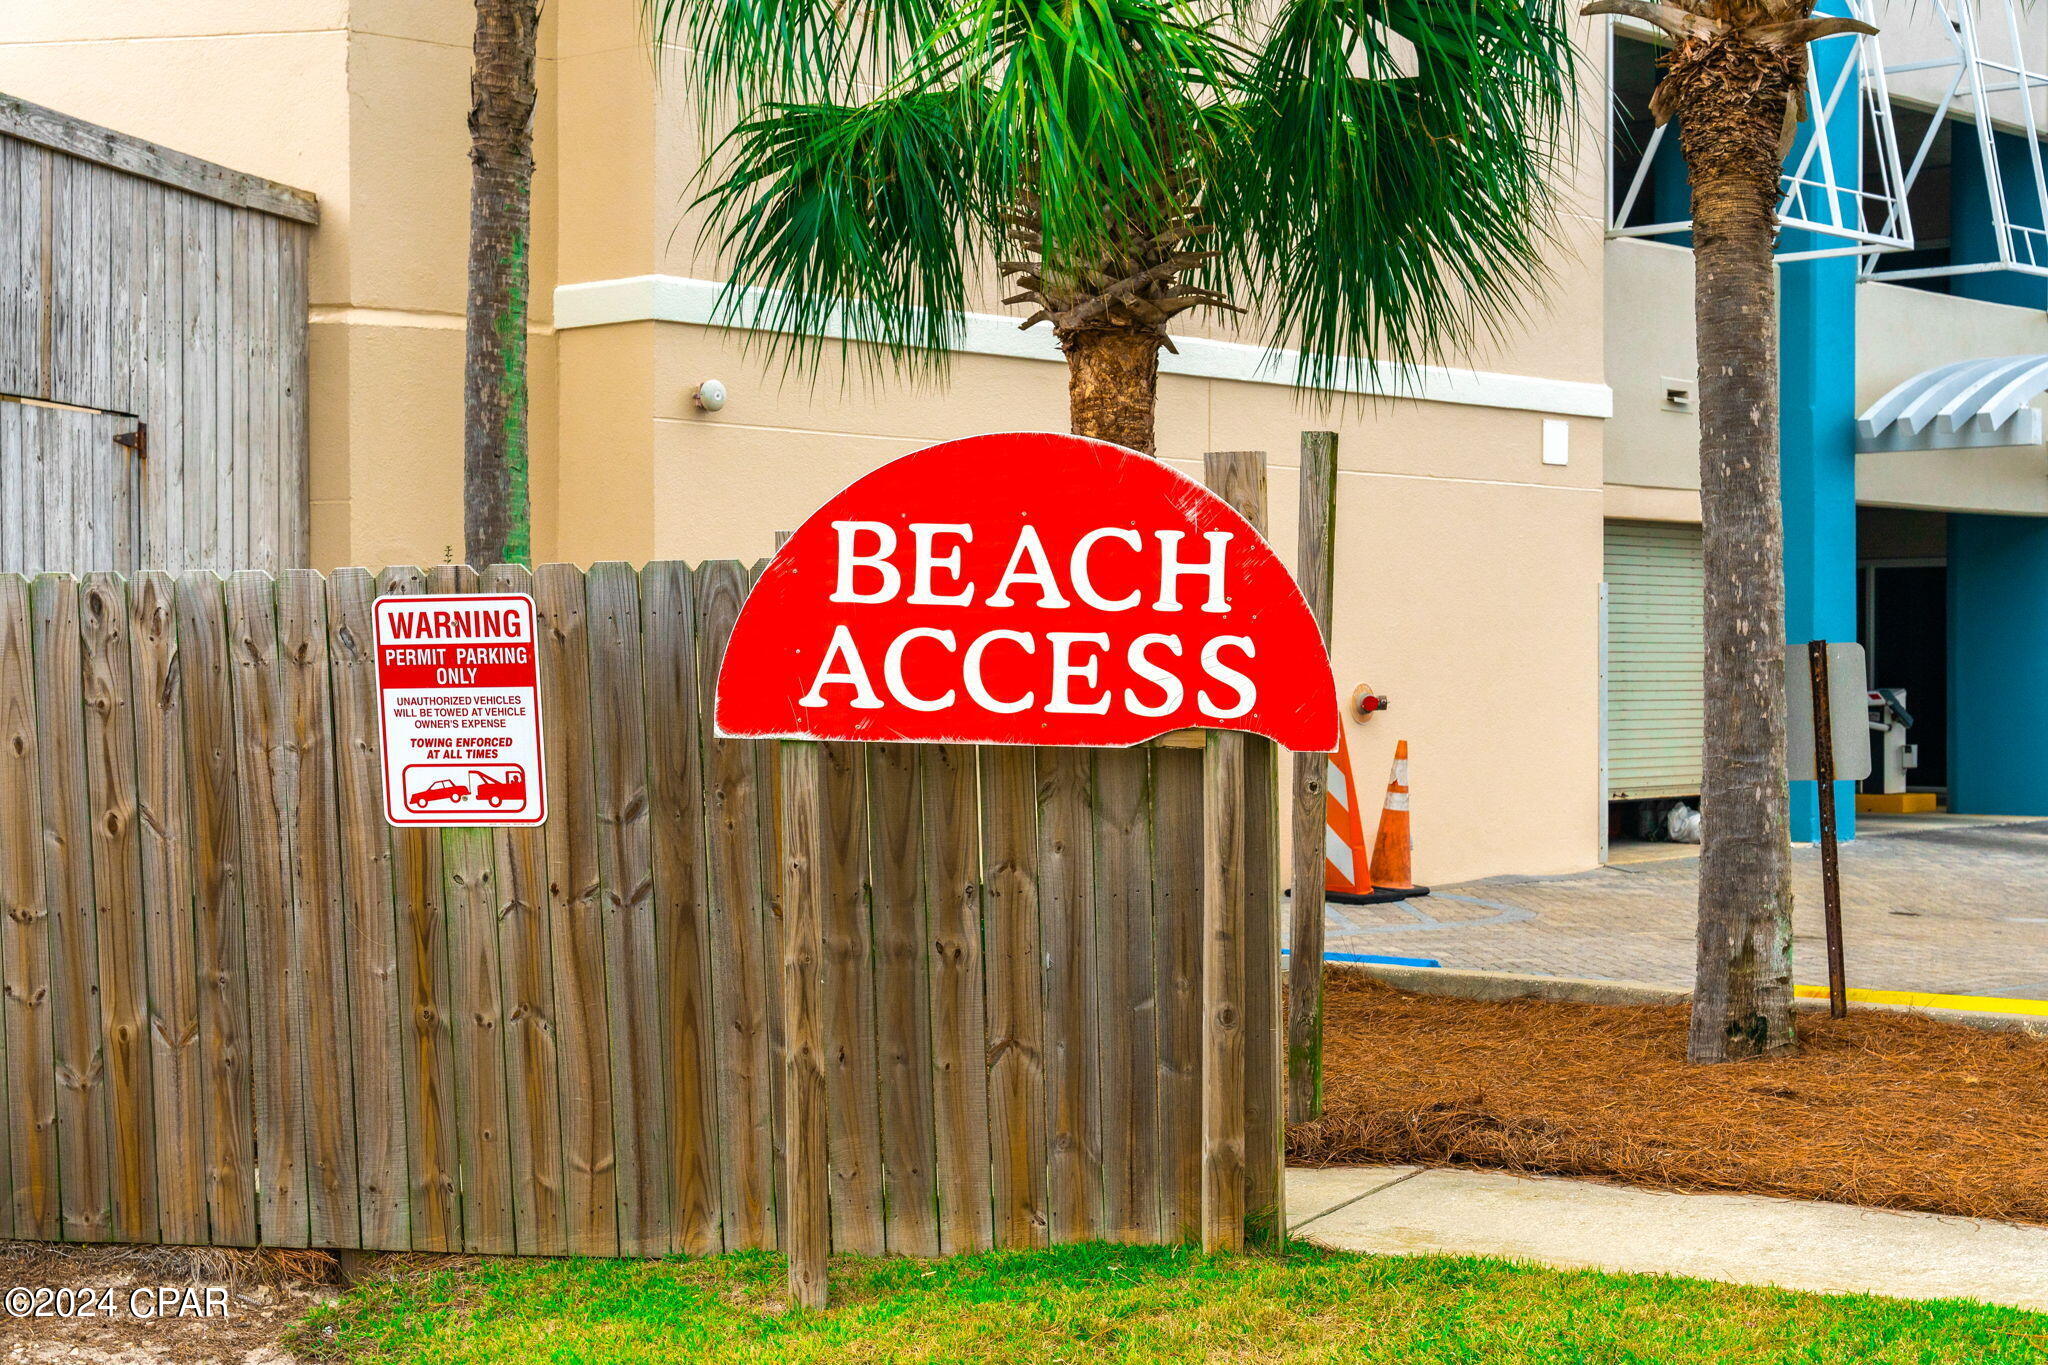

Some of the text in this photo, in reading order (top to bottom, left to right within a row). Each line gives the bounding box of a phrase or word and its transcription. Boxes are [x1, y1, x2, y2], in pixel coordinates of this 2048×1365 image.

[829, 520, 1234, 614] BEACH
[388, 609, 521, 639] WARNING
[385, 646, 528, 666] PERMIT PARKING
[436, 667, 478, 685] ONLY
[798, 625, 1258, 719] ACCESS
[397, 695, 521, 706] UNAUTHORIZED VEHICLES
[394, 707, 526, 718] WILL BE TOWED AT VEHICLE
[414, 719, 507, 729] OWNER'S EXPENSE
[410, 737, 513, 748] TOWING ENFORCED
[427, 749, 499, 759] AT ALL TIMES
